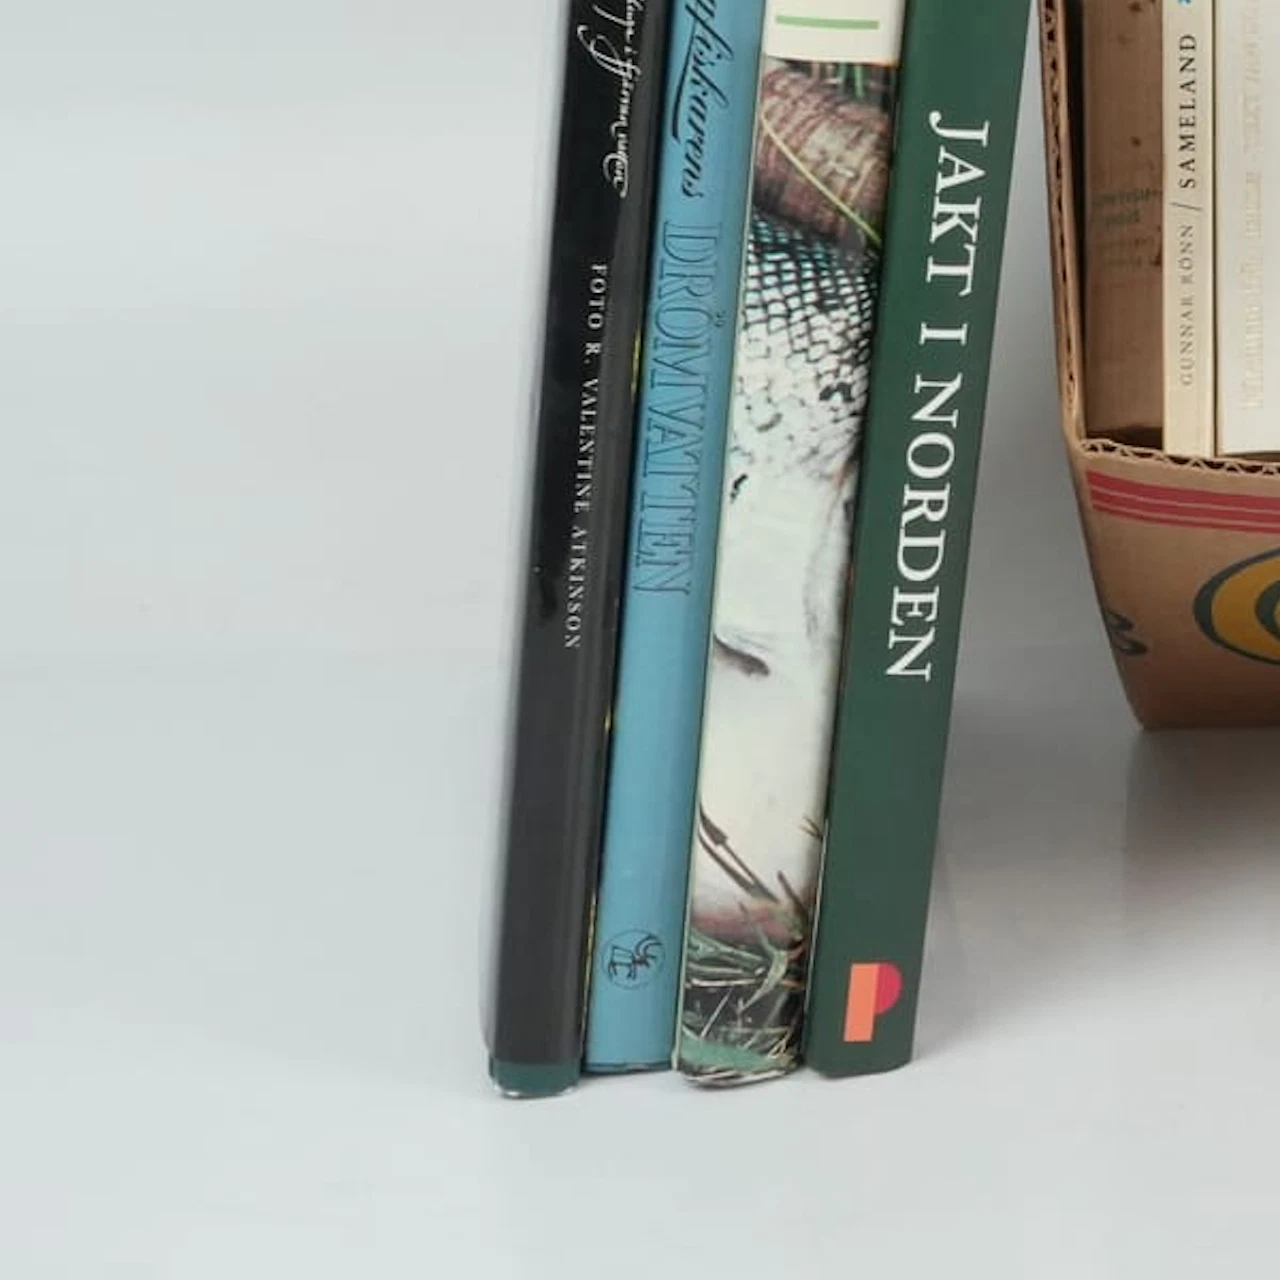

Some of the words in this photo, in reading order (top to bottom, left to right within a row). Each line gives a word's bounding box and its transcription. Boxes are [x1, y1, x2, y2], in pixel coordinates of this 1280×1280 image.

[1176, 33, 1198, 190] SAMELAND
[925, 109, 991, 297] JAKT
[582, 341, 601, 367] R.
[587, 263, 607, 331] FOTO
[918, 320, 969, 347] I
[1178, 296, 1195, 387] GUNNAR
[572, 377, 600, 515] VALENTINE
[632, 218, 726, 598] DRÖMVATTEN
[562, 525, 589, 651] ATKINSON
[883, 371, 966, 682] NORDEN
